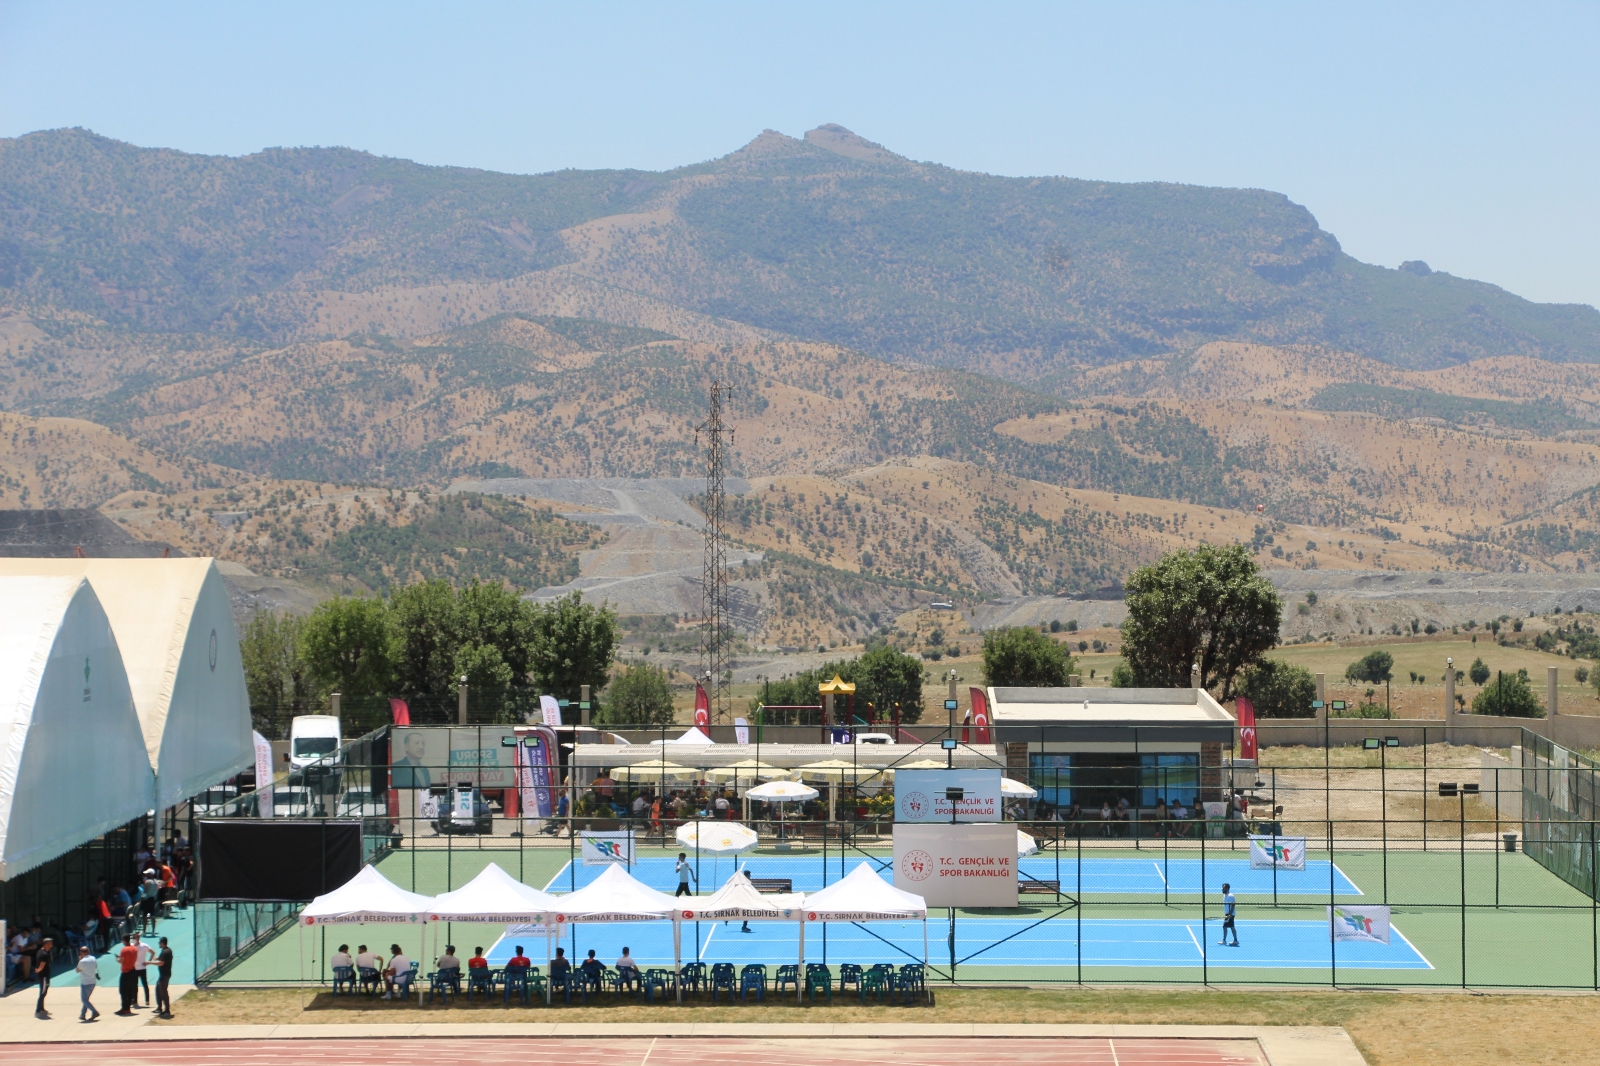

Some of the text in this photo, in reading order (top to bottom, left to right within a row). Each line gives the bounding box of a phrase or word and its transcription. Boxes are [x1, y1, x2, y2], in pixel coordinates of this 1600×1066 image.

[955, 807, 994, 815] BAKANLIĞI
[940, 856, 1010, 867] T.C. GENÇLİK VE
[940, 868, 1010, 877] SPOR BAKANLIĞI
[699, 911, 712, 919] T.C.
[742, 908, 779, 918] BELEDİYESİ
